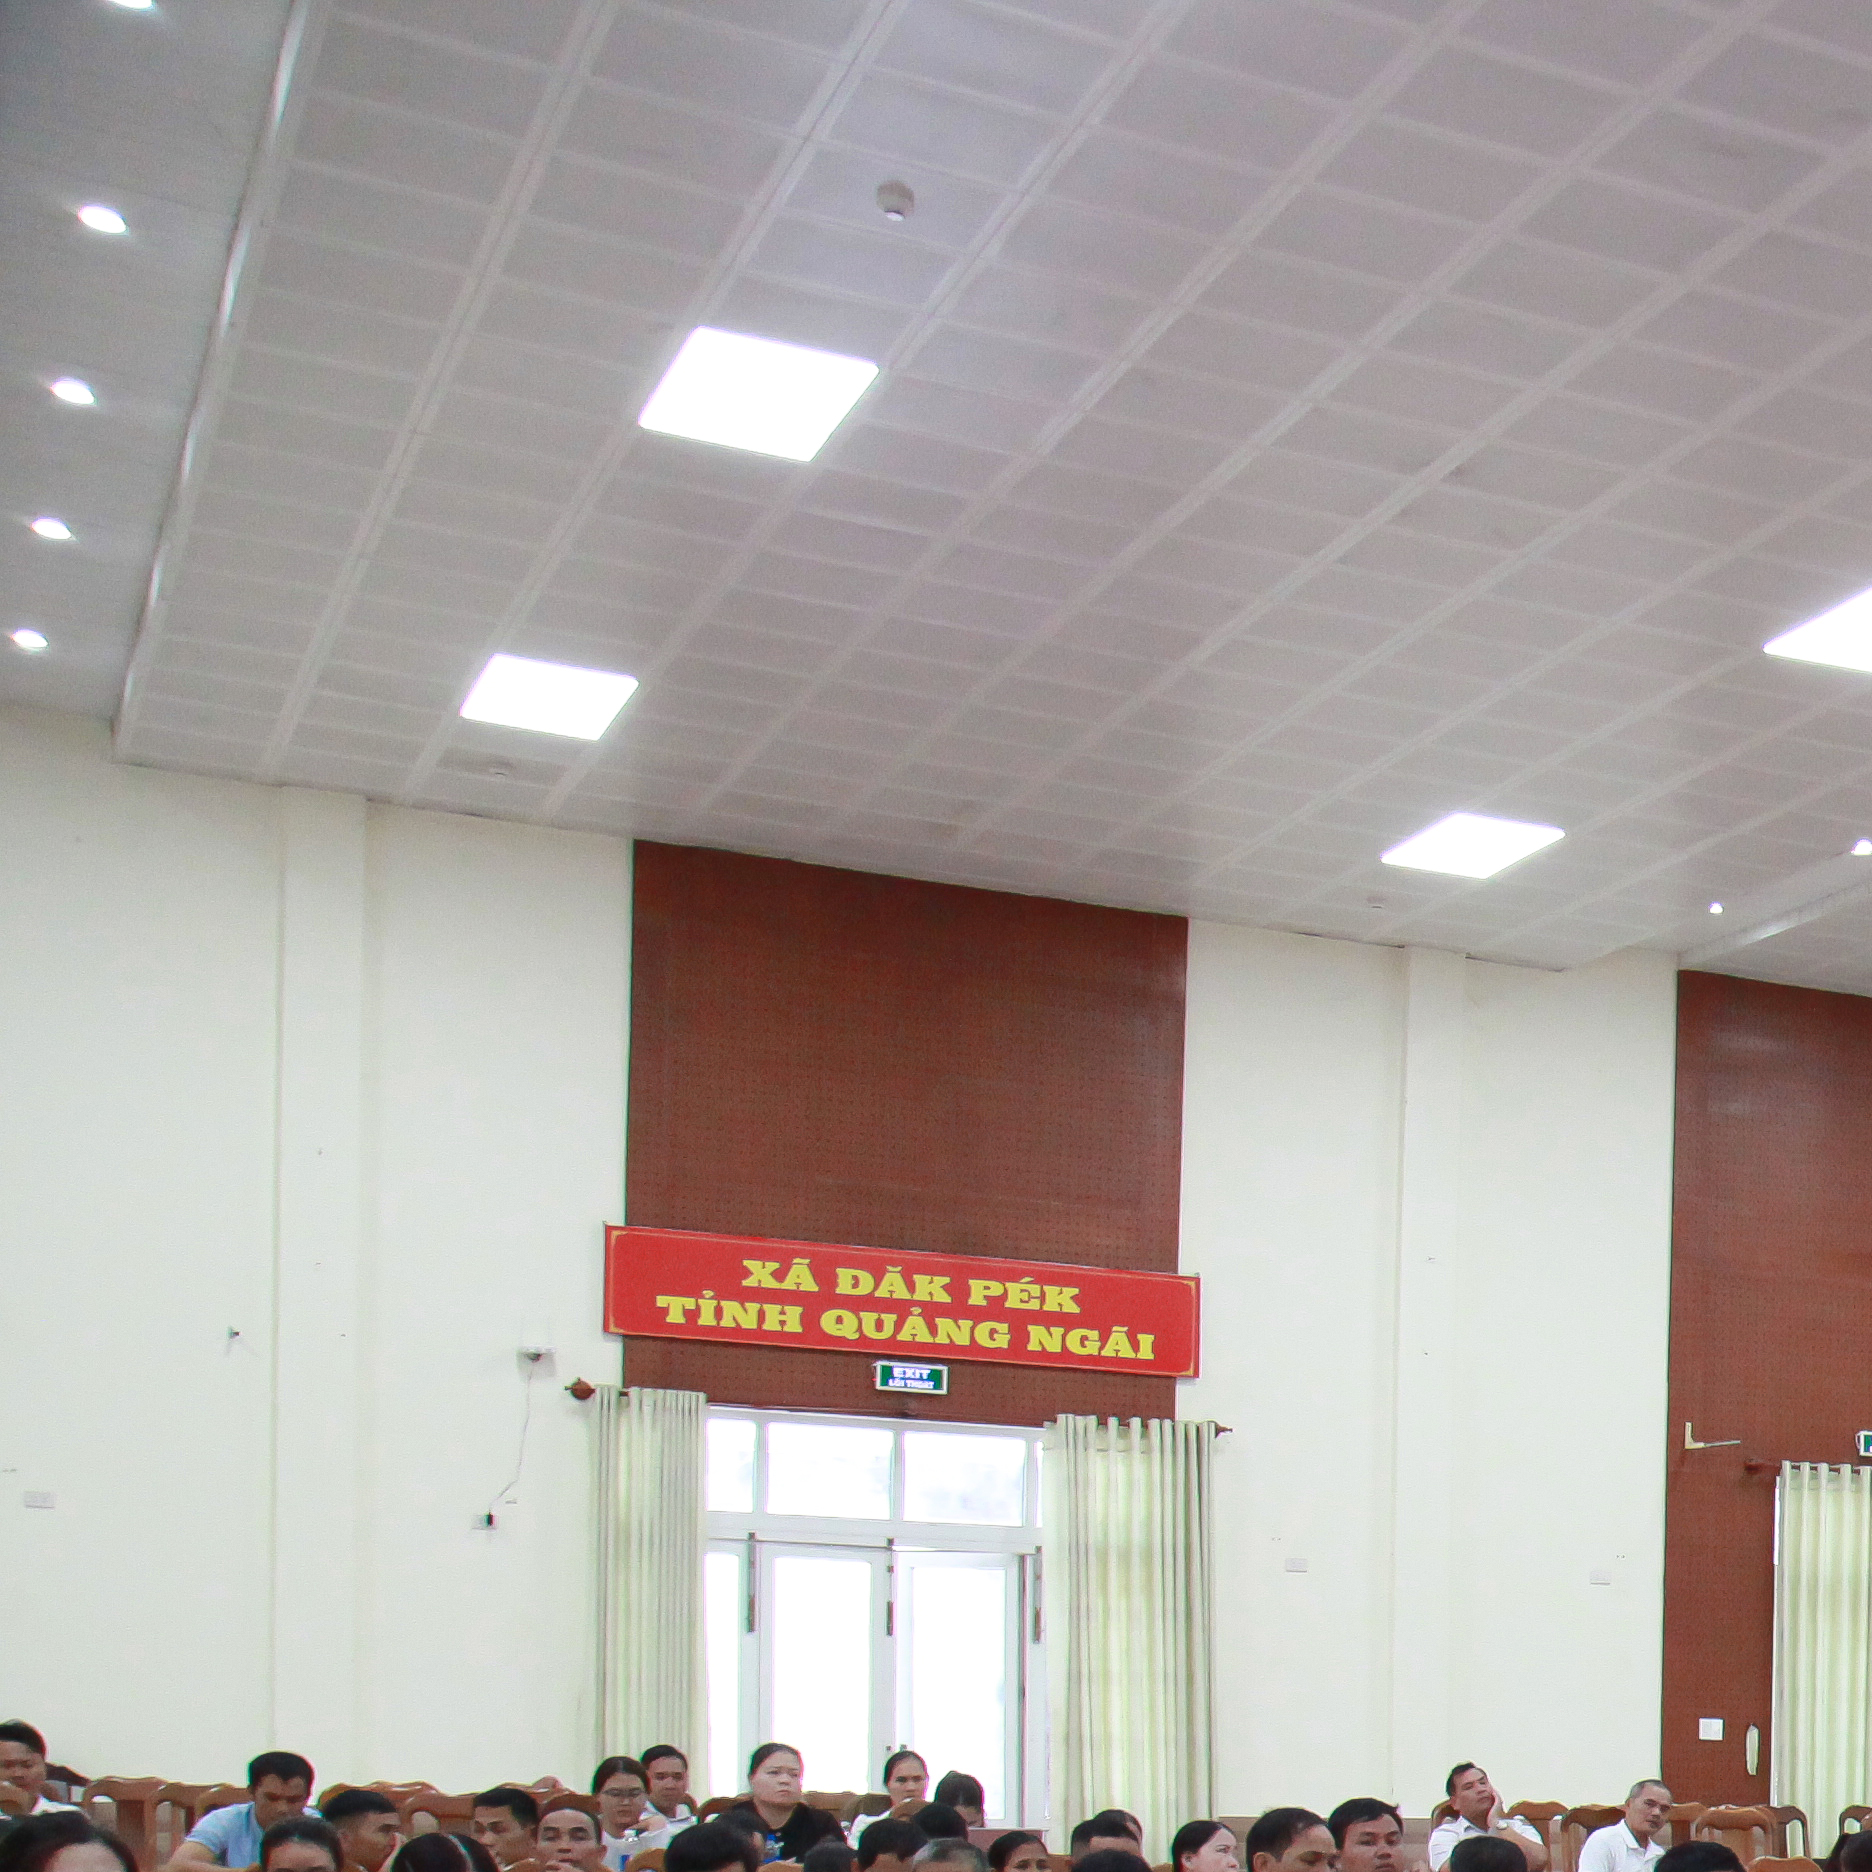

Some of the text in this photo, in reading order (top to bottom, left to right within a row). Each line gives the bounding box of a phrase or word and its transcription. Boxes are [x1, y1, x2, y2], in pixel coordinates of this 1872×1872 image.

[742, 1258, 1081, 1314] XÃ ĐĂK PÉK
[656, 1290, 1156, 1360] TỈNH QUẢNG NGÃI
[893, 1367, 931, 1379] EXIT
